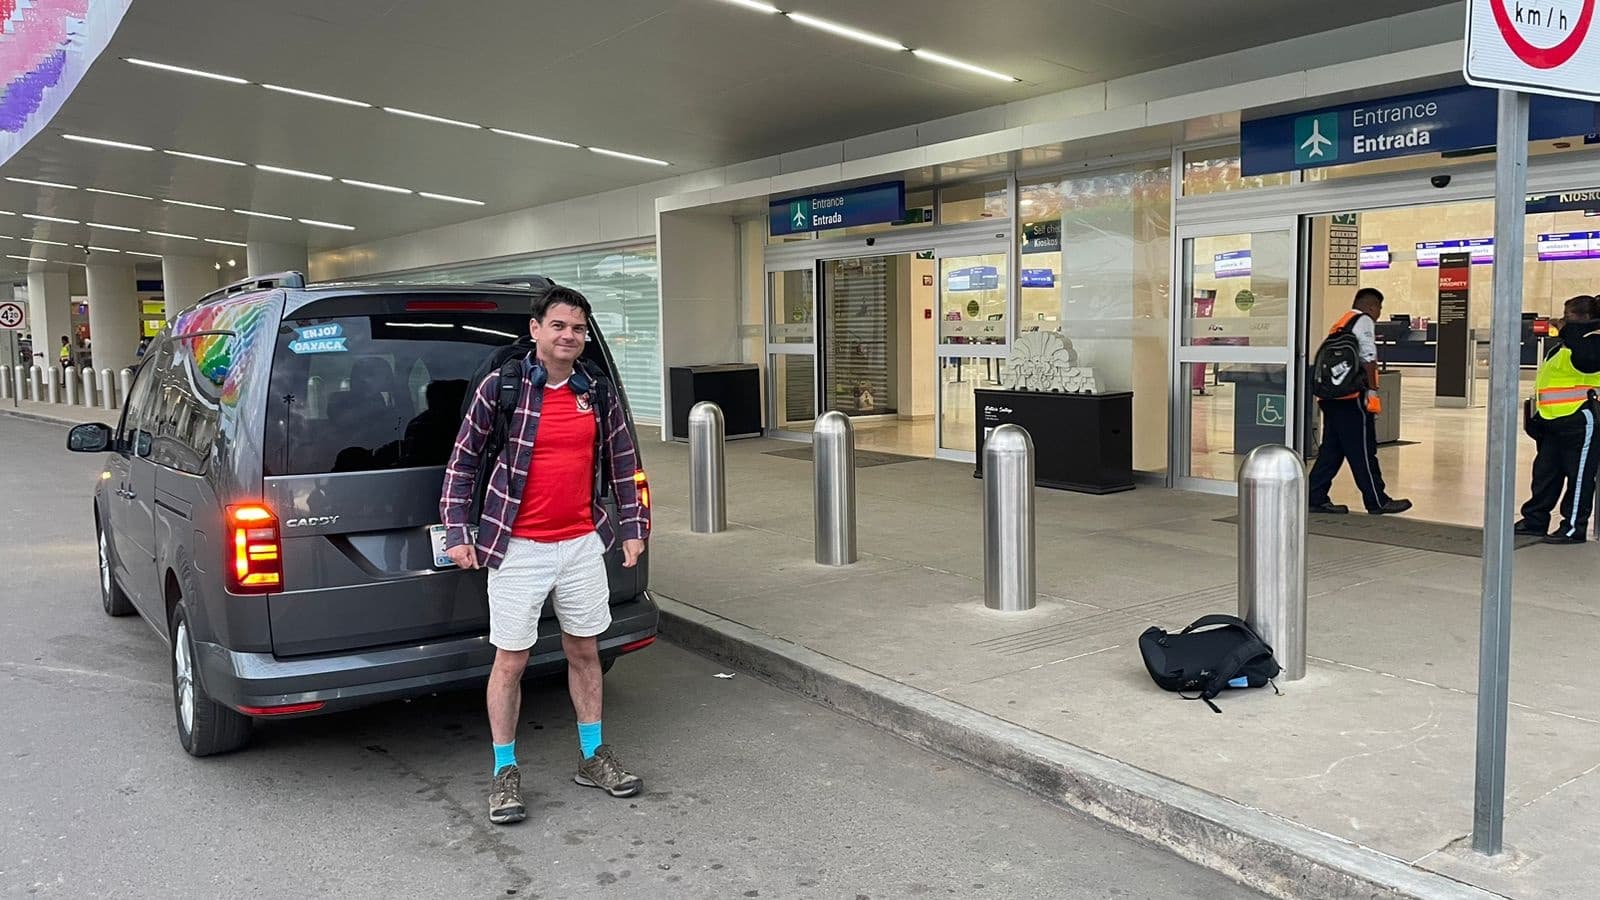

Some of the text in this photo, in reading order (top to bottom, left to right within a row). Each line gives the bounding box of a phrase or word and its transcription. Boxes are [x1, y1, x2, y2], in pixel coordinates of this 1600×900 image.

[1515, 1, 1567, 30] km/h
[1353, 102, 1437, 128] Entrance
[1353, 127, 1430, 154] Entrada
[812, 196, 844, 210] Entrance
[812, 211, 842, 226] Entrada
[302, 325, 338, 339] ENJOY
[294, 341, 342, 352] OAXACA
[286, 515, 340, 528] CADDY
